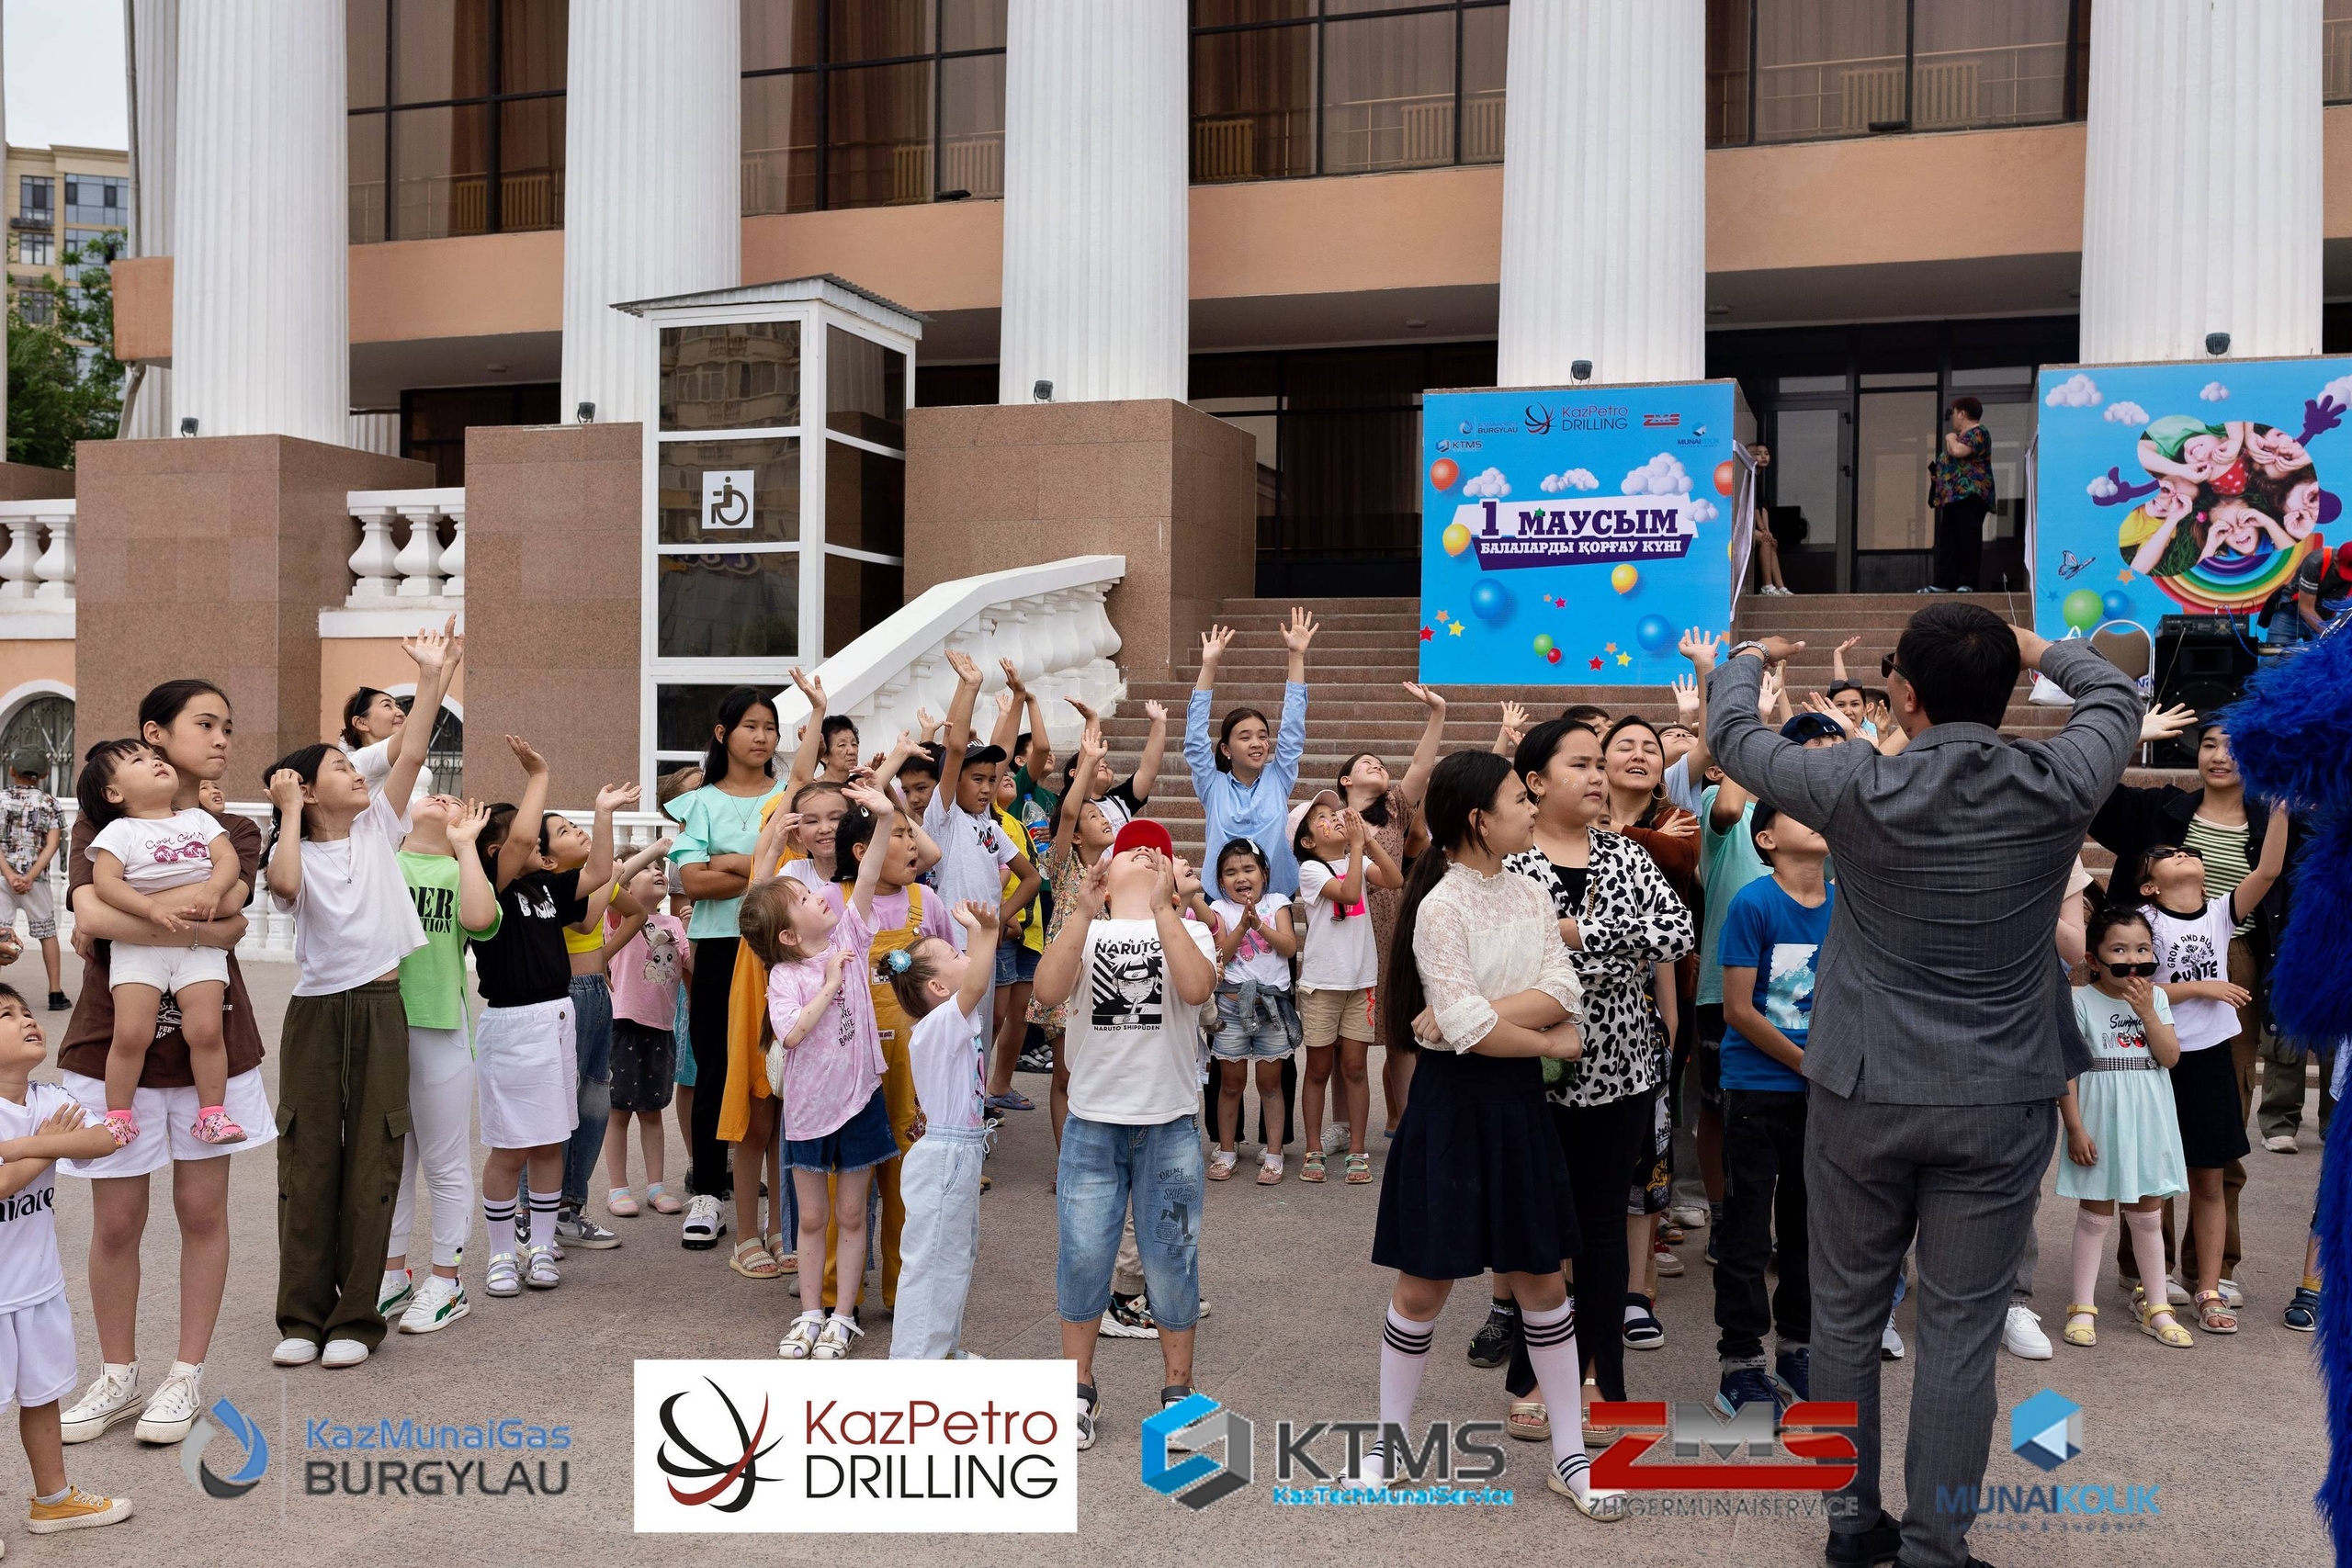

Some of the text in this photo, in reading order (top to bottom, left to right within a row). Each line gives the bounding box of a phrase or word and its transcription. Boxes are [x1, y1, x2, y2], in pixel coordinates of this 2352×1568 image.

[1562, 405, 1628, 418] KazPetro
[1562, 418, 1628, 431] DRILLING
[1643, 413, 1680, 426] ZMS
[1453, 440, 1483, 448] KTMS
[1482, 501, 1679, 536] 1 МАУСЫМ
[1480, 542, 1575, 556] БАЛАЛАРДЫ
[1578, 540, 1638, 556] ҚОРҒАУ
[1094, 941, 1162, 954] NARUTO
[2167, 942, 2180, 968] GROW
[2181, 934, 2198, 942] AND
[839, 1030, 855, 1046] BRIGH
[1164, 1188, 1182, 1200] SKIP
